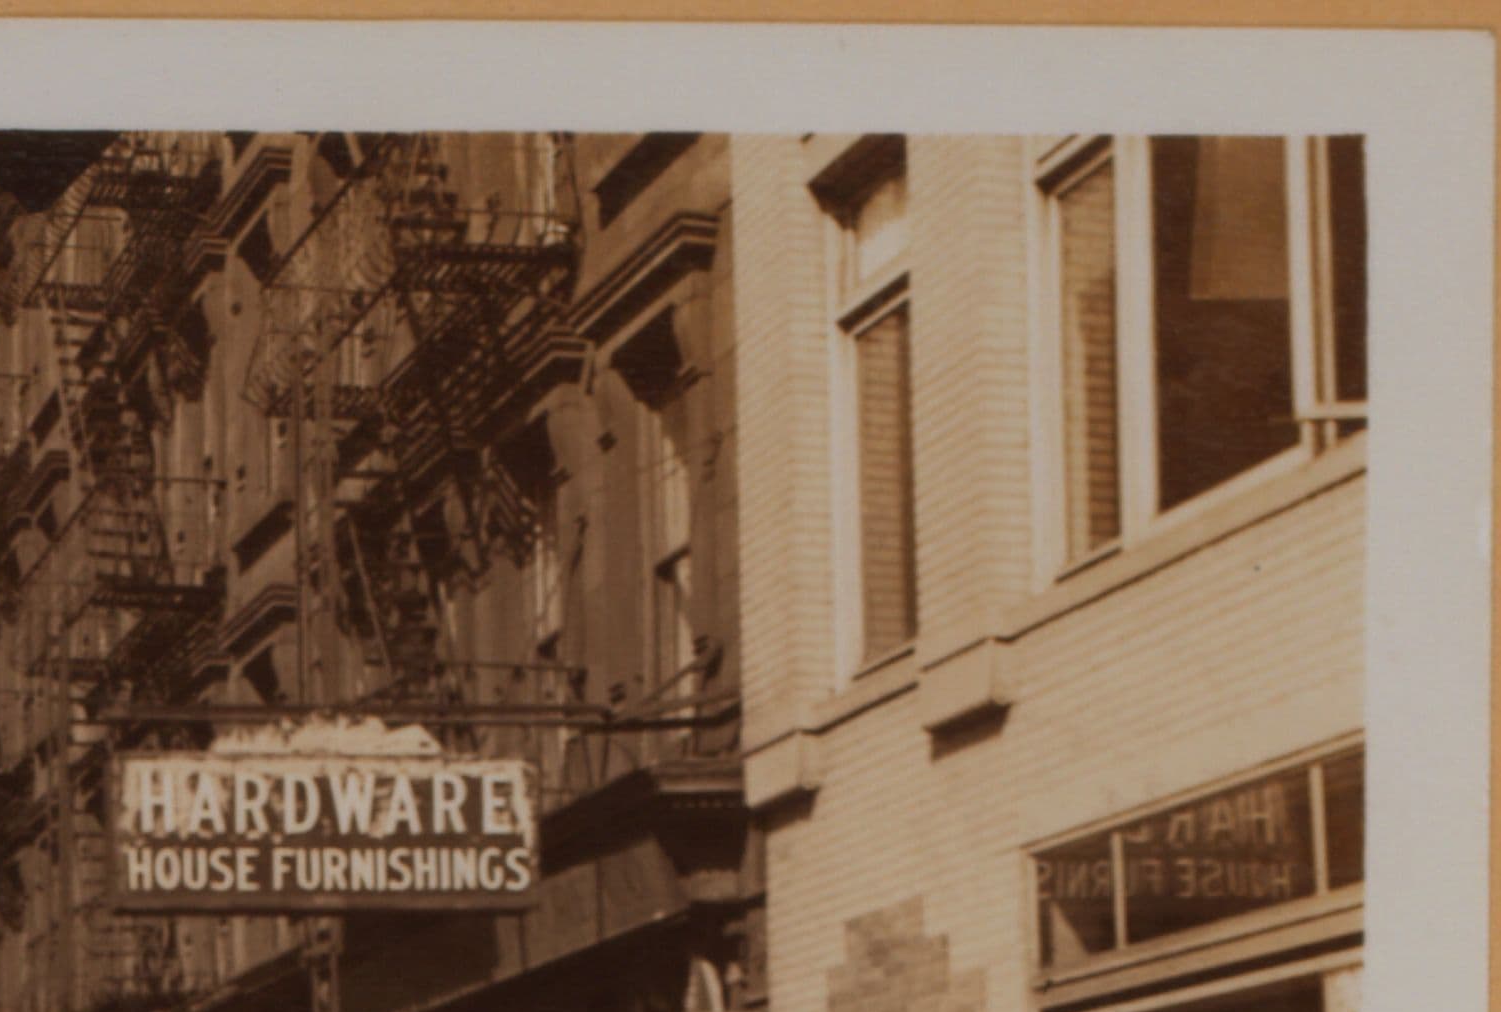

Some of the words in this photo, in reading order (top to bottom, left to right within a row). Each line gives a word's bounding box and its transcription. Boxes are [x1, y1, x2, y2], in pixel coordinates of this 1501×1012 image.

[140, 772, 516, 836] HARDWARE
[128, 846, 260, 890] HOUSE
[273, 846, 532, 891] FURNISHINGS
